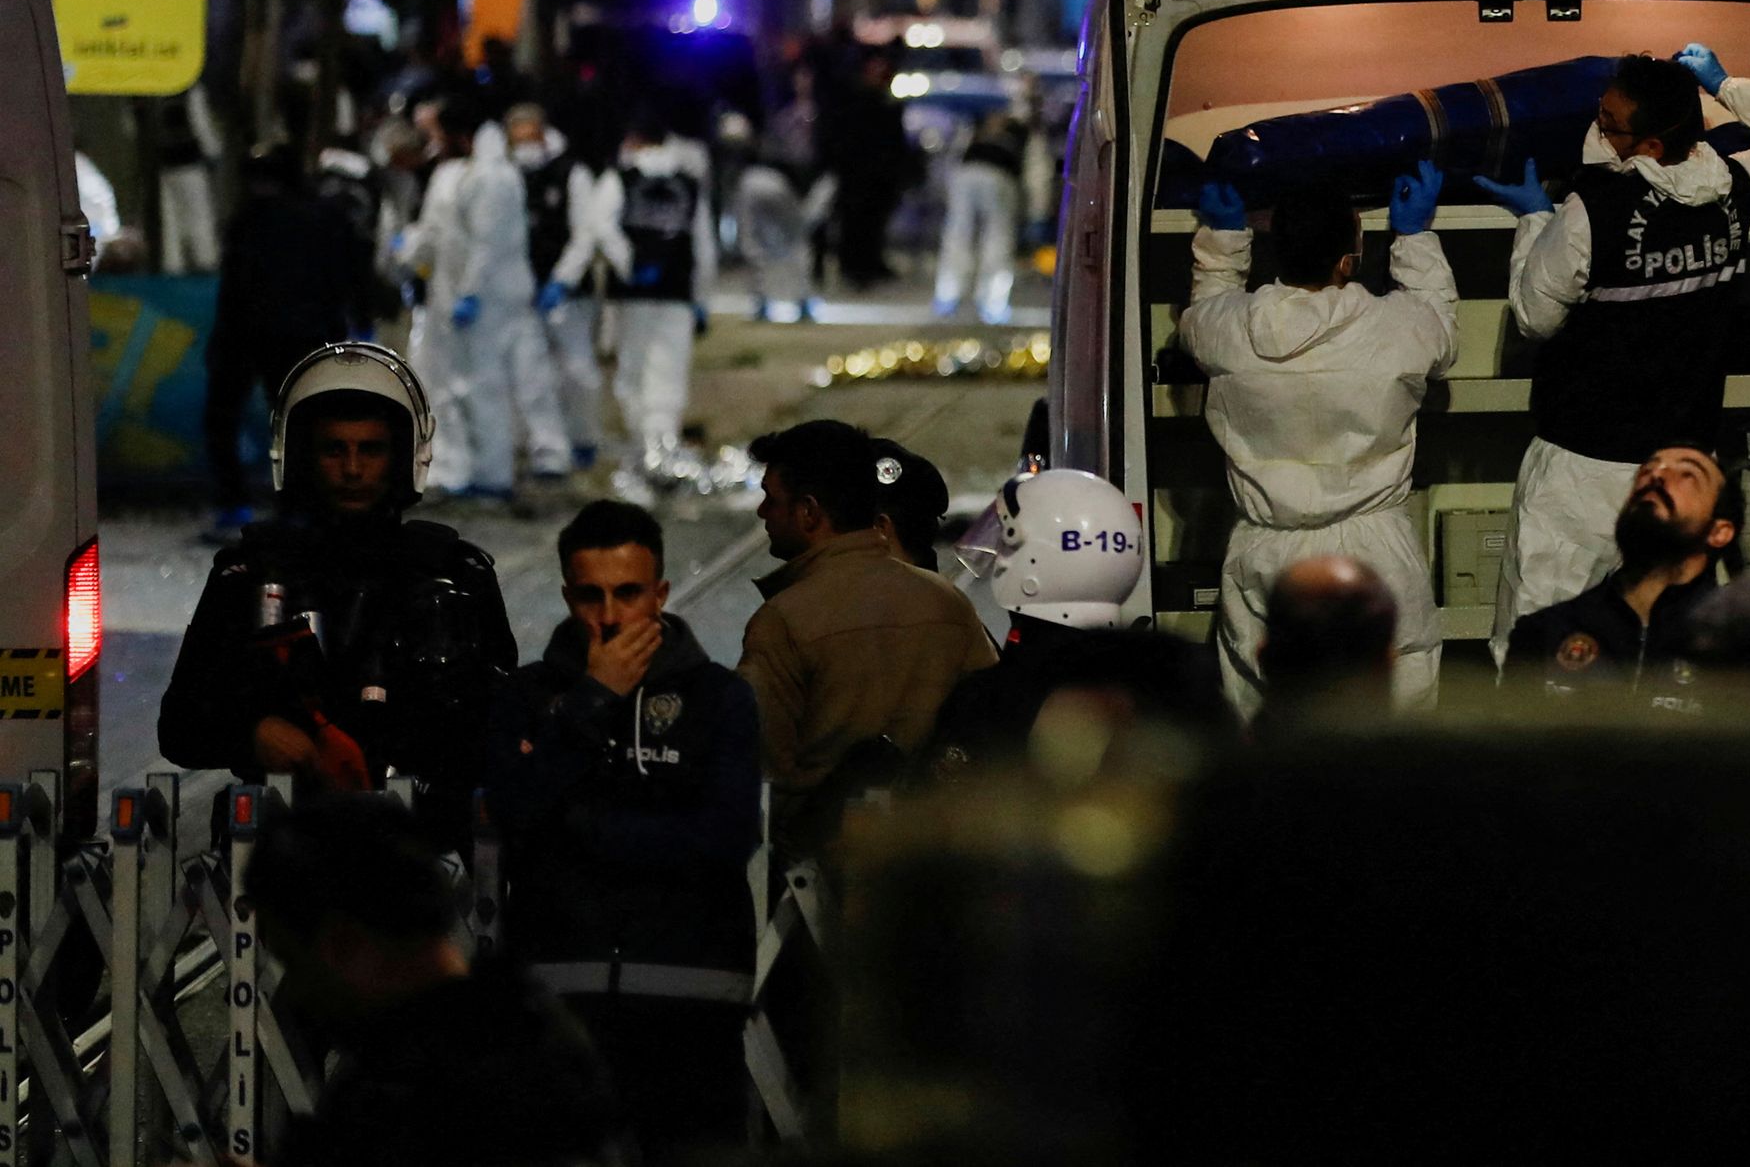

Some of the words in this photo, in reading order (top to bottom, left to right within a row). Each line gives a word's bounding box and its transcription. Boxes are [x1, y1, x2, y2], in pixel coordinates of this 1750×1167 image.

[1625, 209, 1648, 271] OLAY
[1644, 234, 1729, 278] POLİS
[1, 675, 35, 697] ME
[626, 745, 680, 764] POLİS
[233, 932, 254, 1155] POLİS
